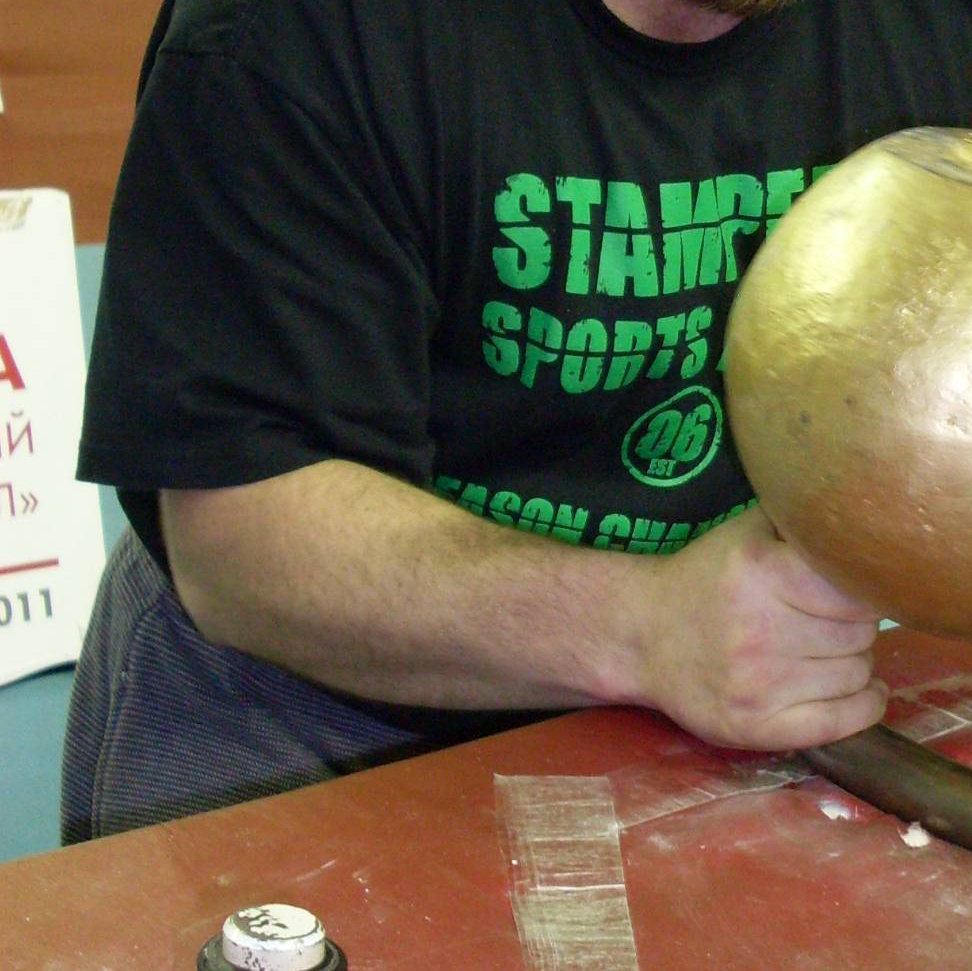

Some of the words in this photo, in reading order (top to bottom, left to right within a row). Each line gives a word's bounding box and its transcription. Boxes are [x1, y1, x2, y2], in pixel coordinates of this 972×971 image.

[481, 301, 714, 394] SPORTS
[635, 403, 712, 461] 06
[647, 458, 677, 477] EST
